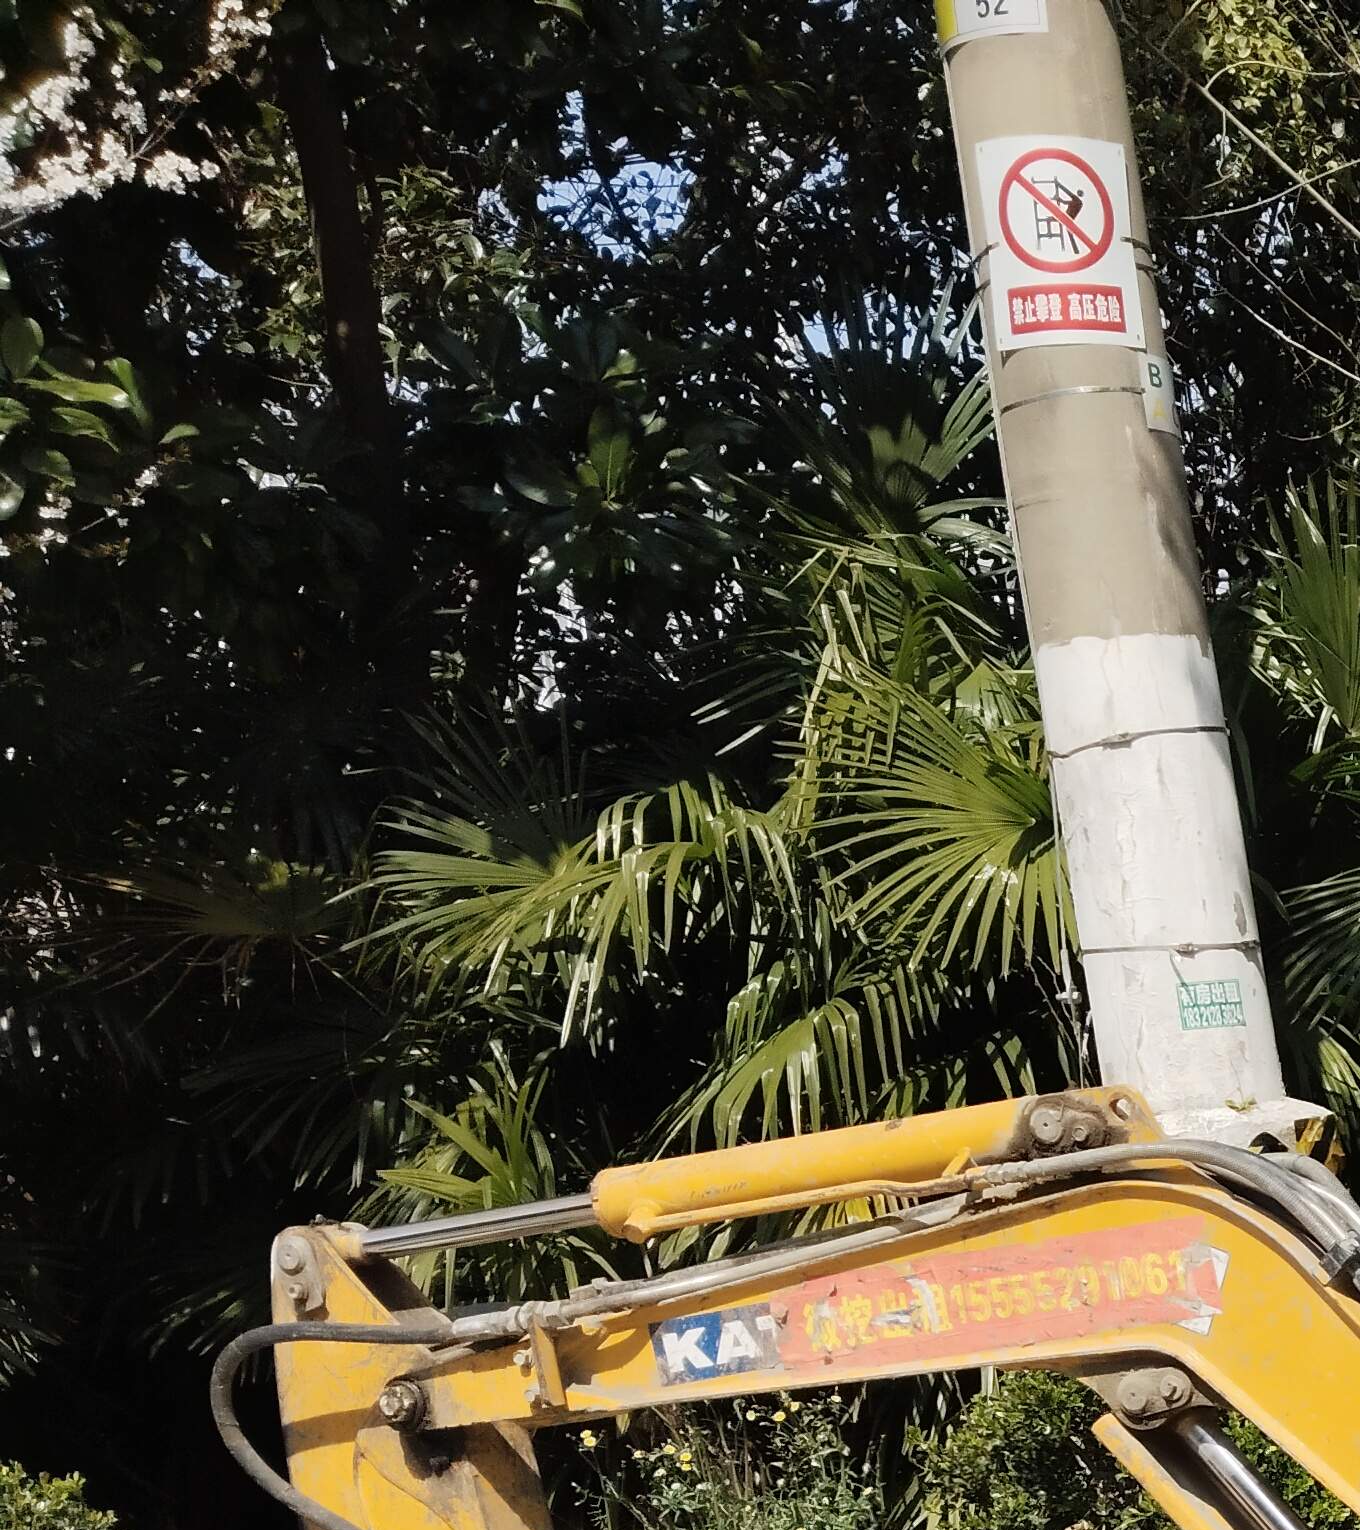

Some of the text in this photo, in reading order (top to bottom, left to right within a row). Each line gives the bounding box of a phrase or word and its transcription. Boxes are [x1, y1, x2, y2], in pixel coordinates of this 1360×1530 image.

[1013, 292, 1122, 325] 禁止攀登 高压危险
[1148, 362, 1162, 388] B
